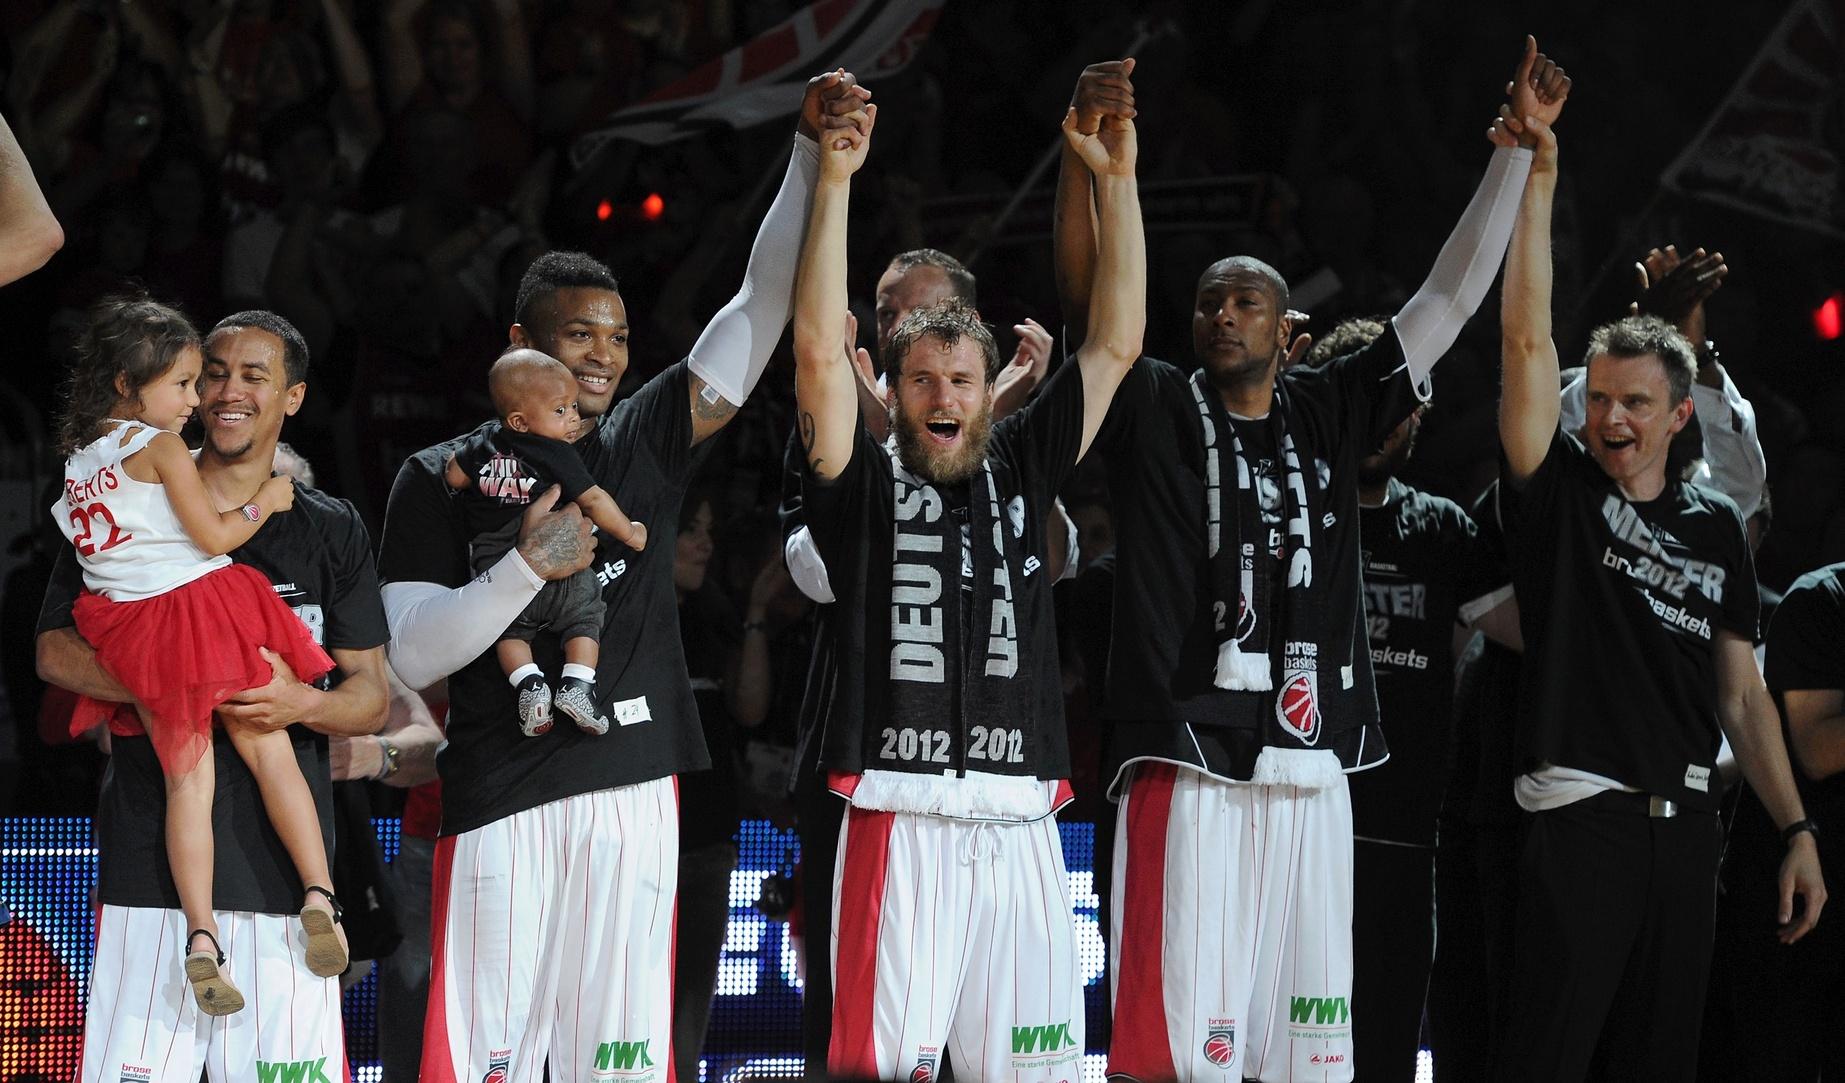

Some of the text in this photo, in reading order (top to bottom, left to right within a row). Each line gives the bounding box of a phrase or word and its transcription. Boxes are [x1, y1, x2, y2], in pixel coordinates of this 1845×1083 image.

[479, 476, 537, 499] WAY
[69, 502, 133, 557] 22
[1634, 556, 1691, 600] 2012
[1370, 646, 1429, 669] skets
[879, 727, 951, 763] 2012
[967, 725, 1024, 763] 2012
[1011, 1018, 1076, 1053] WWK
[121, 1063, 152, 1074] brose
[256, 1056, 333, 1083] WWK
[1323, 1054, 1344, 1063] JAKO
